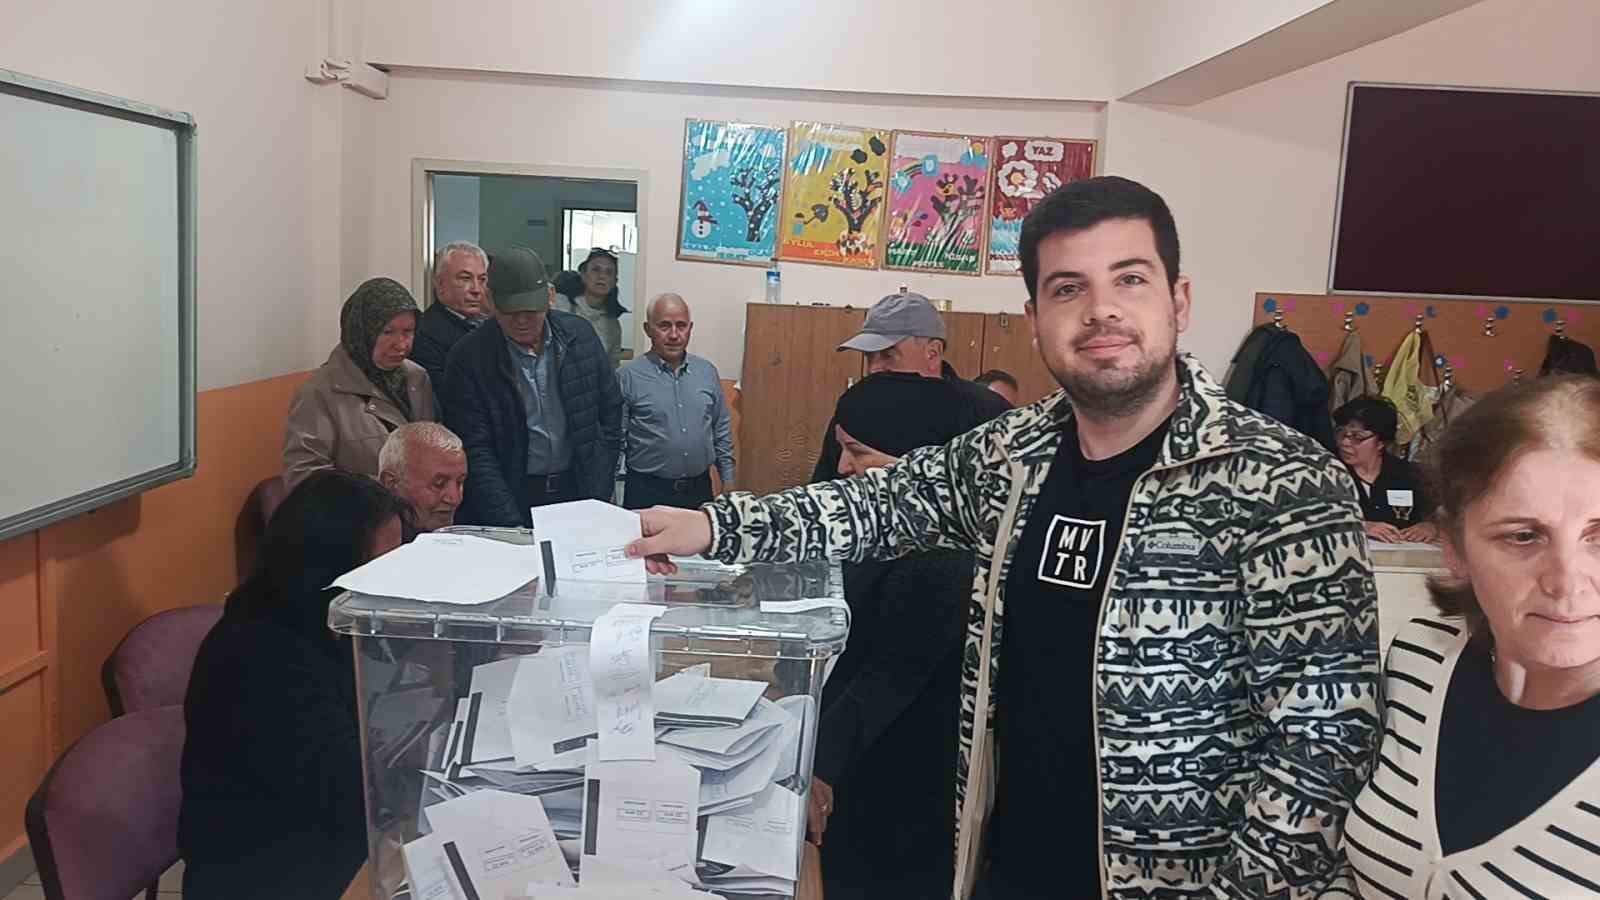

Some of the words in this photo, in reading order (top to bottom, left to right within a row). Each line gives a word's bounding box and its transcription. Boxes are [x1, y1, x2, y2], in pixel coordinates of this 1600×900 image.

[1032, 146, 1054, 157] YAZ
[1059, 525, 1093, 551] MV
[1054, 552, 1088, 582] TR
